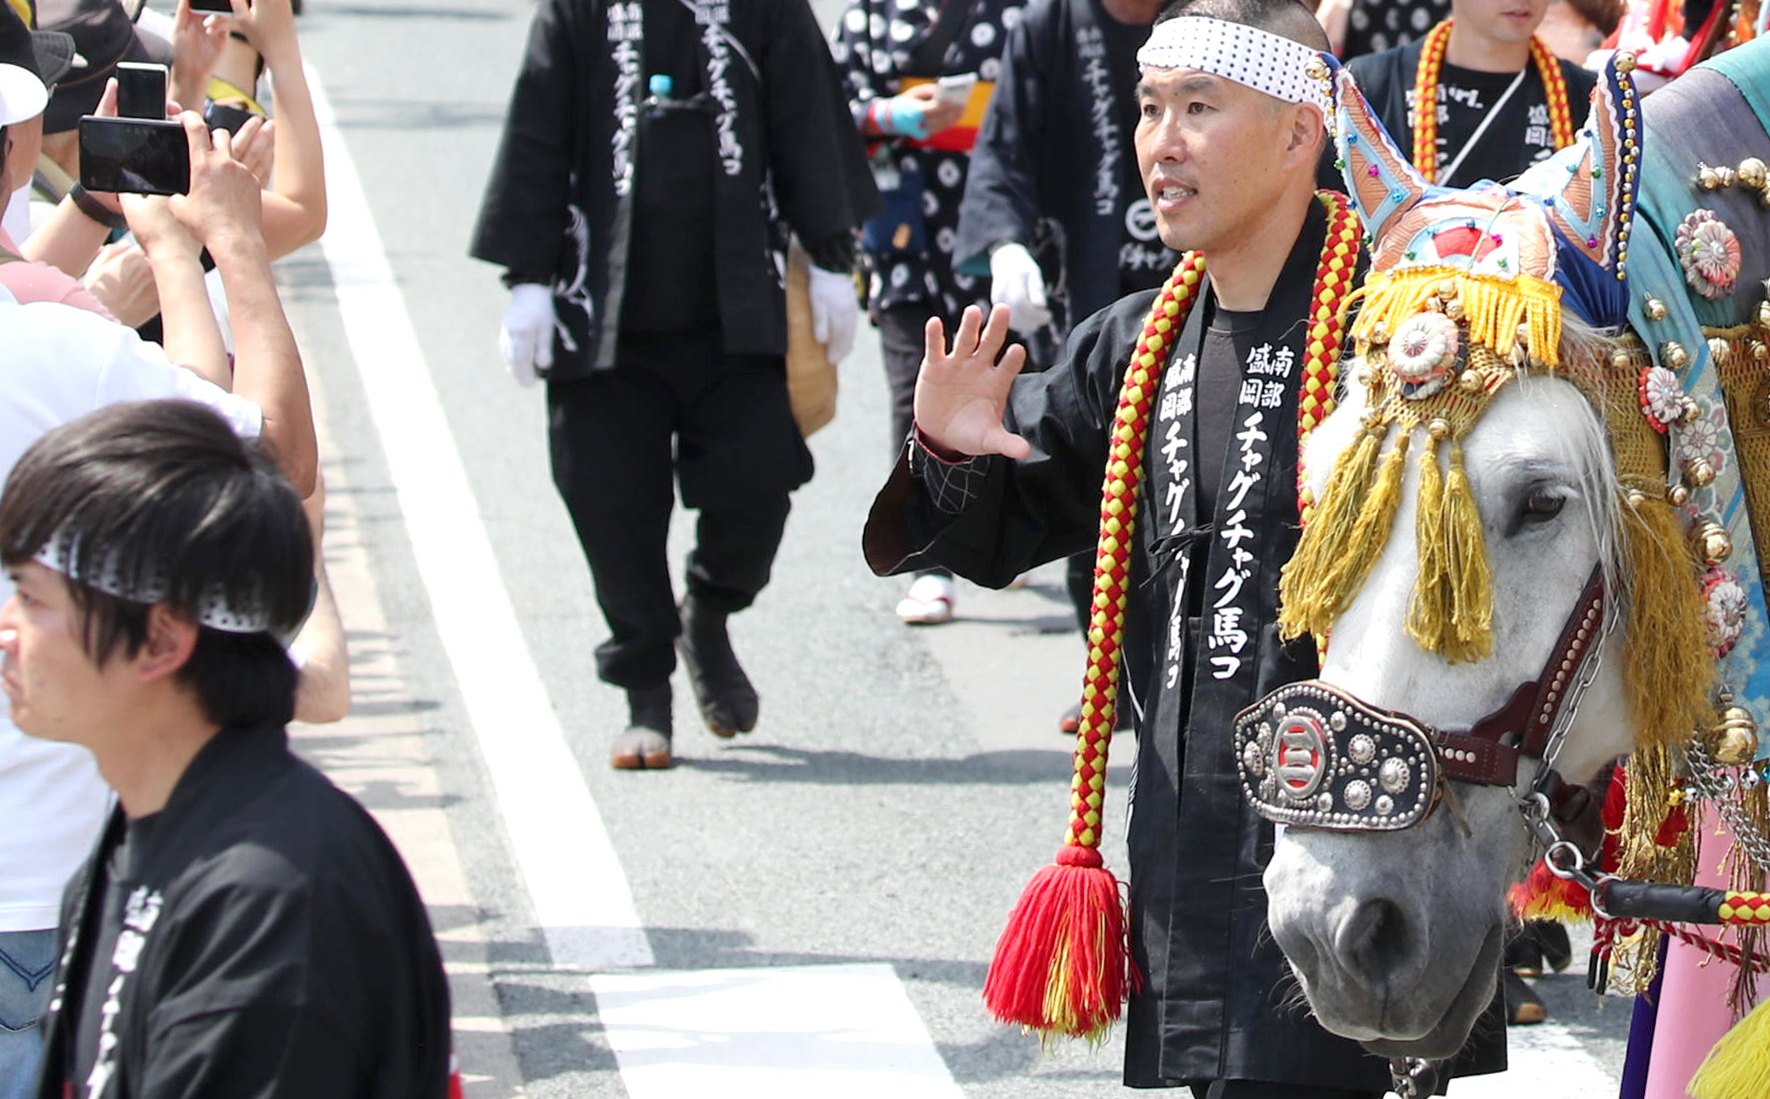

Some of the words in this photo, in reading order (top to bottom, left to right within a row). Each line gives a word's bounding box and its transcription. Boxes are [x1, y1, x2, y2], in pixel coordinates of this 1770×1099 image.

[1159, 357, 1182, 422] 盛岡
[1178, 353, 1196, 417] 南部
[1239, 343, 1273, 407] 盛岡
[1261, 346, 1295, 410] 南部
[1207, 411, 1269, 680] チャグチャグ馬コ
